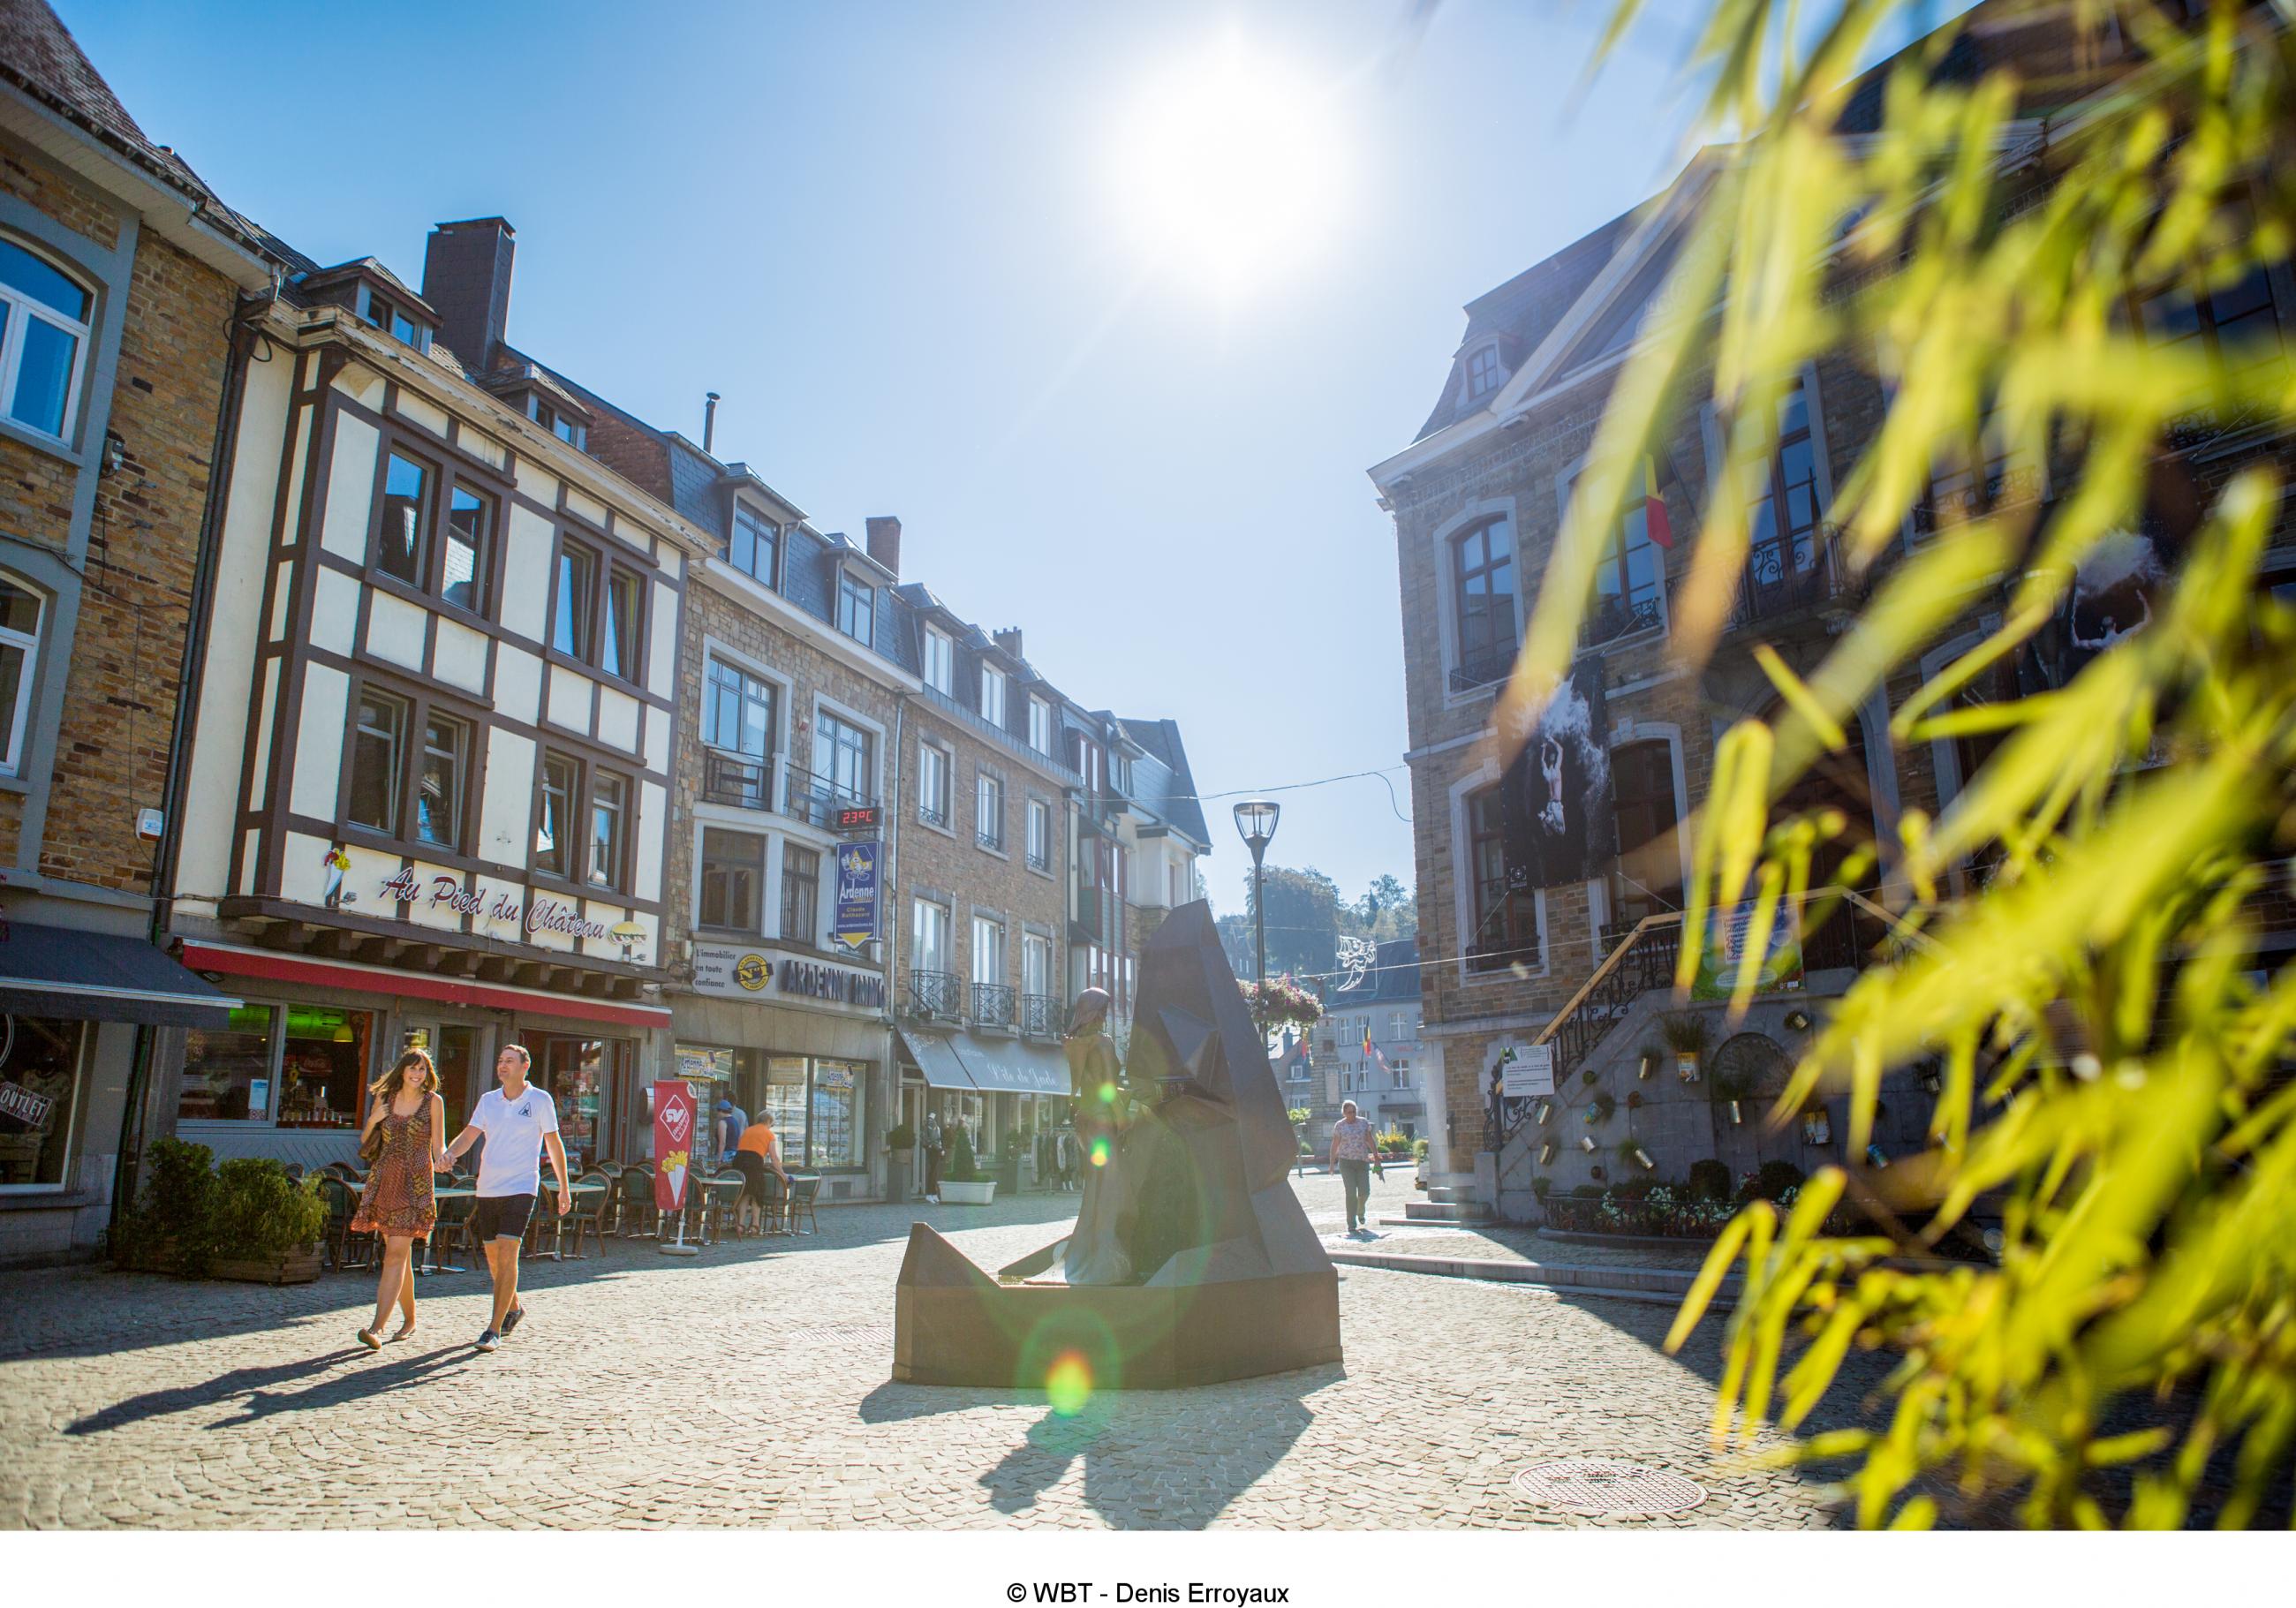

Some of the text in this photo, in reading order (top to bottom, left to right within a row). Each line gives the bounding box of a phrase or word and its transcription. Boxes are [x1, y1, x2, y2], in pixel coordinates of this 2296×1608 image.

[839, 879, 874, 904] Ardenne
[379, 866, 605, 940] Au Pied du Château
[696, 948, 736, 960] L'immobilier
[706, 964, 723, 973] toute
[695, 977, 726, 988] confiance
[782, 960, 849, 1001] ARDENN
[1017, 1067, 1030, 1083] de
[0, 1089, 47, 1117] OUTLET
